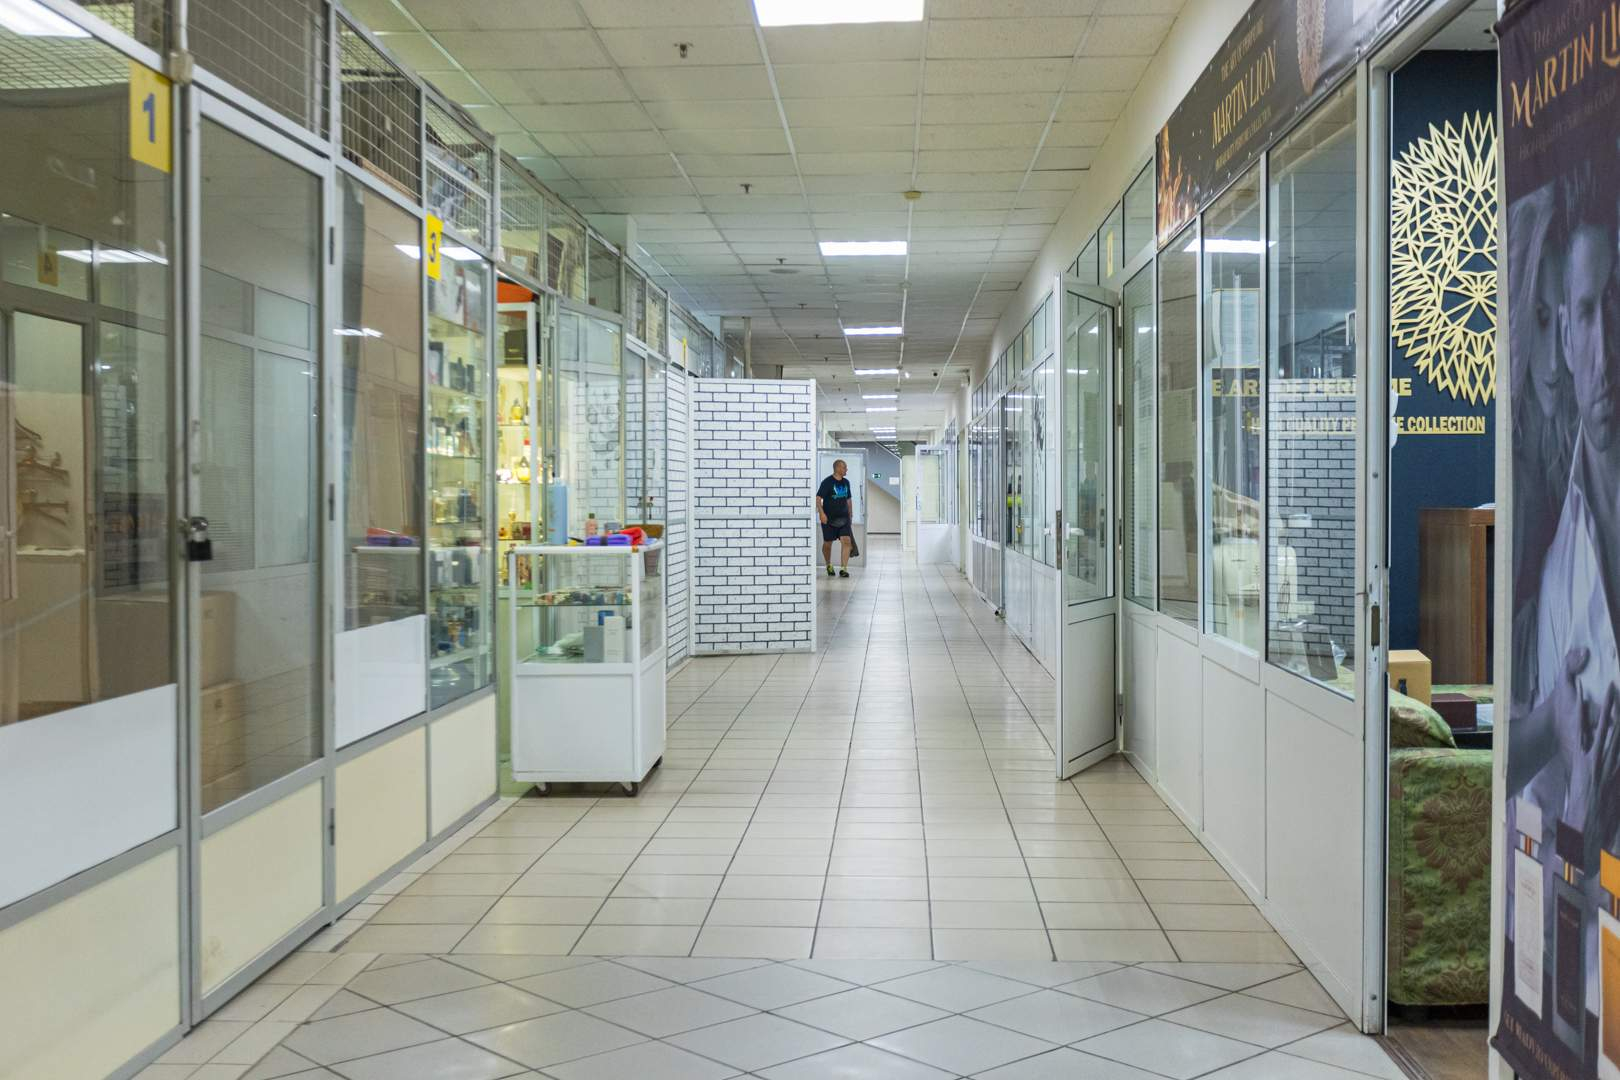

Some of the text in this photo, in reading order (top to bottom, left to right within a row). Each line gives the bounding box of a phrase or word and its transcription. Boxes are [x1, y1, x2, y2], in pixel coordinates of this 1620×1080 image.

[1510, 23, 1594, 128] MARTIN
[1601, 1, 1620, 68] LI
[1212, 72, 1249, 149] MARTIN
[1250, 39, 1277, 108] LION
[142, 92, 156, 144] 1
[429, 231, 437, 263] 3
[1229, 379, 1260, 396] AR
[1407, 415, 1486, 434] COLLECTION
